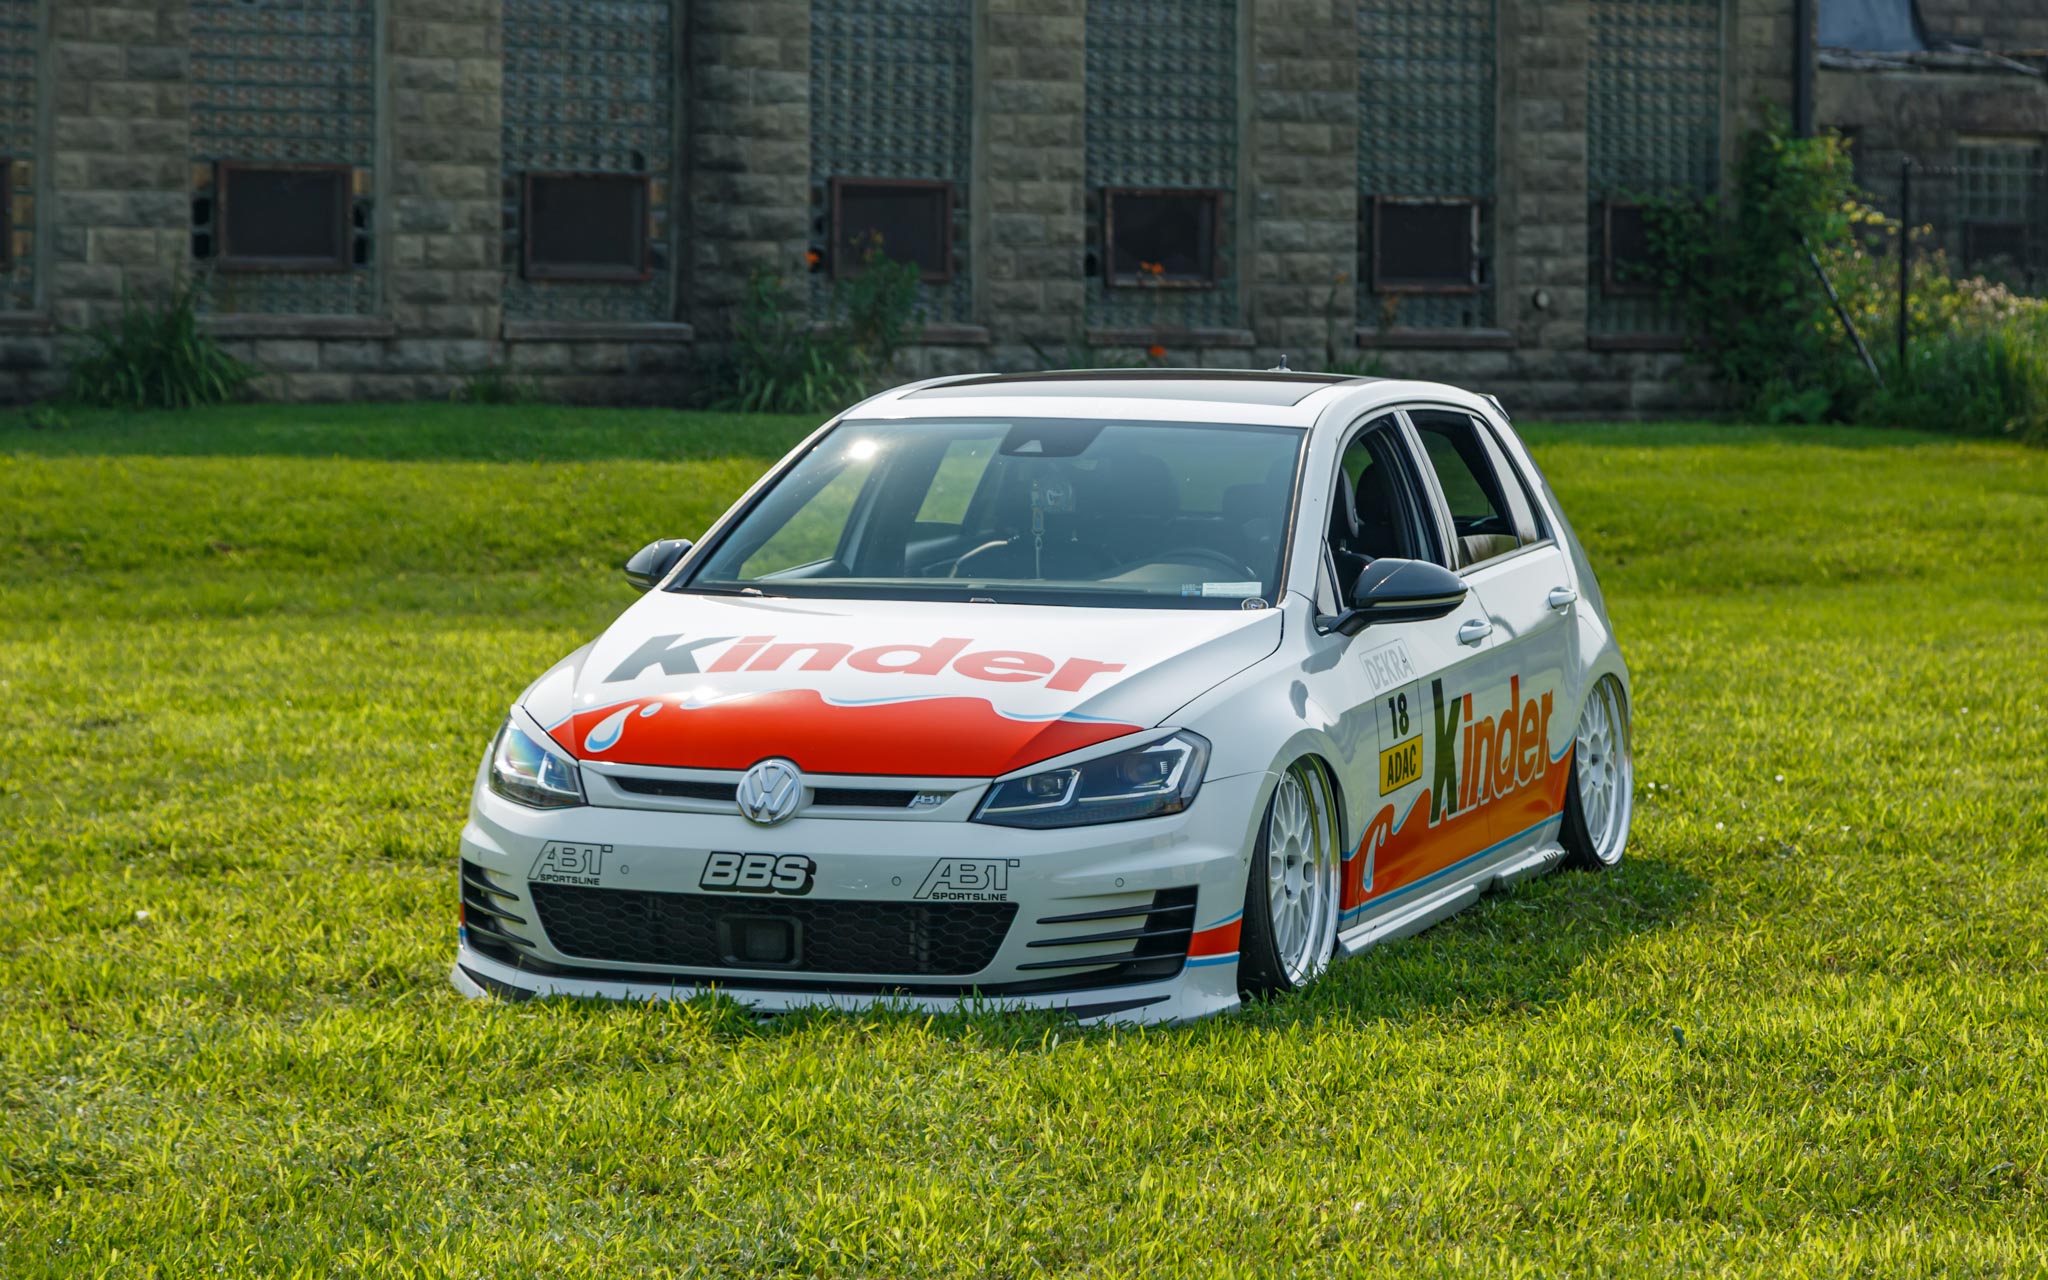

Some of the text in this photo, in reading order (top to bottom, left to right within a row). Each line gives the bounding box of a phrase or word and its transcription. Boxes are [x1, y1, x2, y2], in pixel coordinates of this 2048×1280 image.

[602, 634, 1126, 692] Kinder
[1365, 645, 1414, 690] DEKRA
[1388, 692, 1409, 739] 18
[1387, 744, 1416, 787] ADAC
[1429, 674, 1554, 828] Kinder
[739, 761, 800, 823] VW
[528, 840, 613, 880] ABT
[540, 873, 600, 885] SPORTSLINE
[700, 850, 816, 895] BBS
[913, 857, 1020, 899] ABT
[932, 891, 1007, 902] SPORTSLINE
